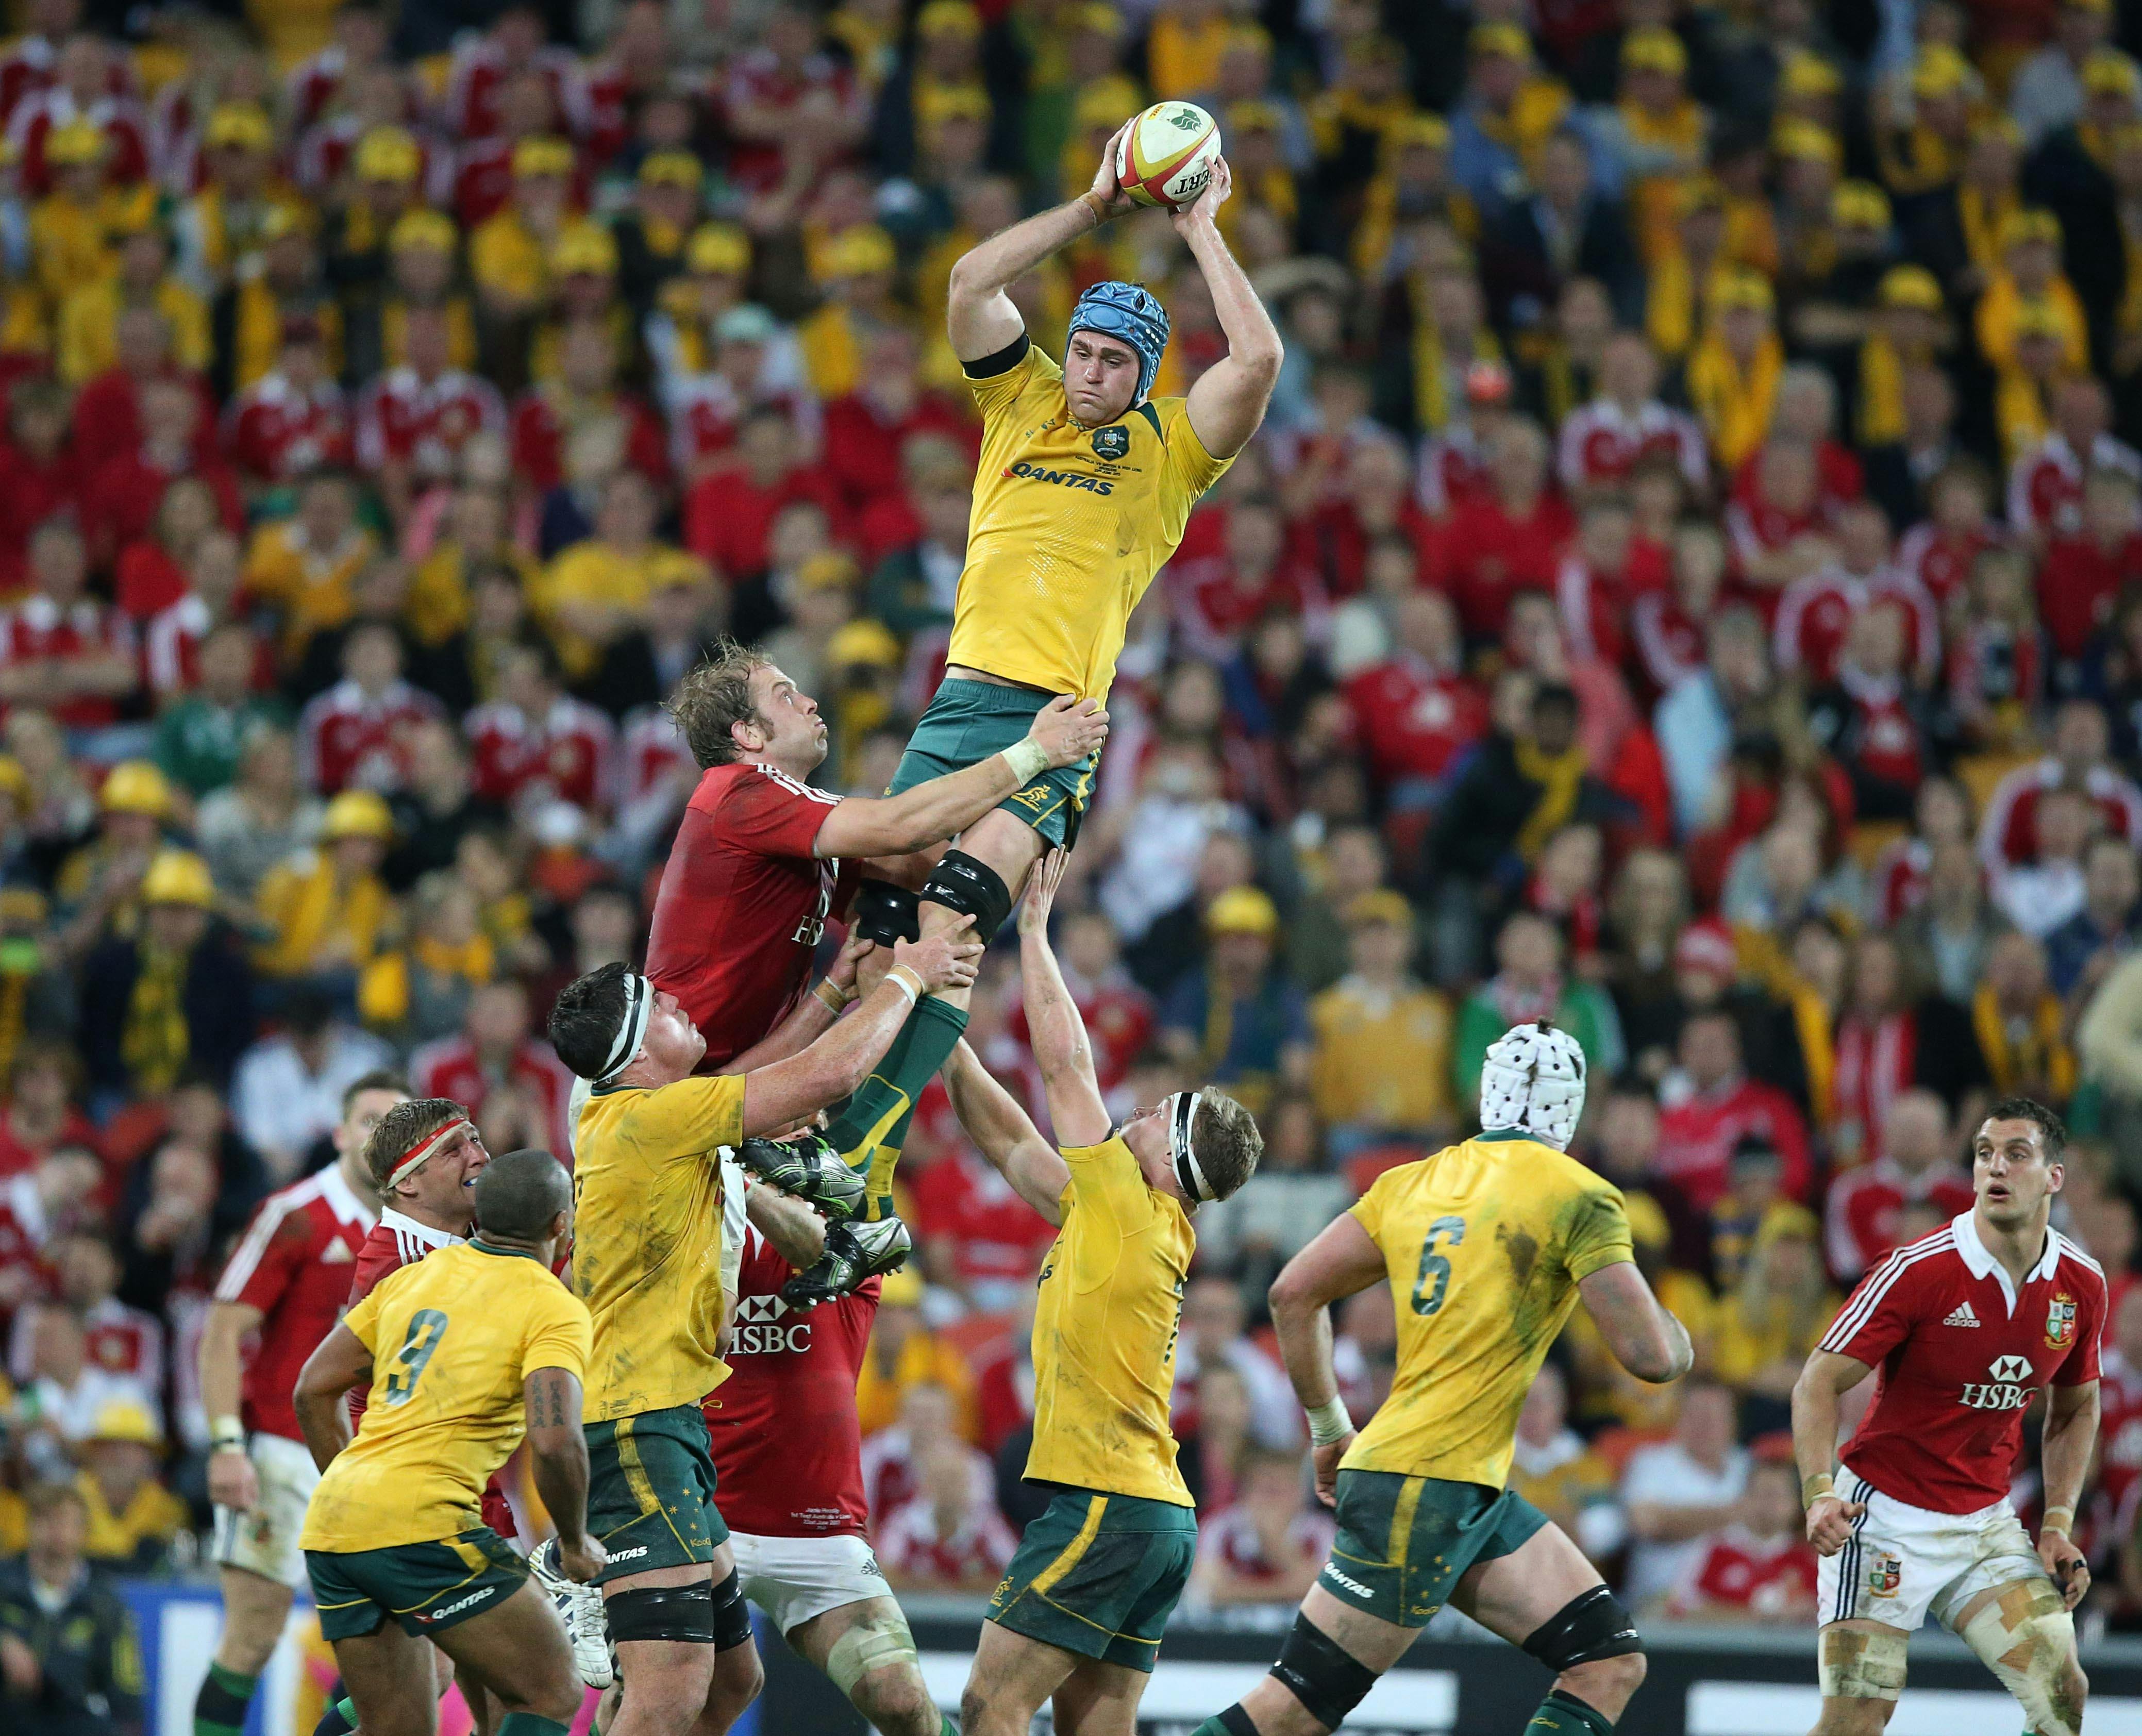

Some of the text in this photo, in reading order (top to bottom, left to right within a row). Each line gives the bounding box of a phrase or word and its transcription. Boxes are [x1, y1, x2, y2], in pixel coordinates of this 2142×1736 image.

[1173, 169, 1211, 195] ERT
[1011, 463, 1114, 495] QANTAS
[1411, 1216, 1466, 1315] 6
[1943, 1317, 1981, 1328] adidas
[386, 1309, 448, 1407] 9
[1958, 1383, 2039, 1410] HSBC
[1324, 1562, 1375, 1598] QANTAS
[431, 1585, 495, 1620] QANTAS
